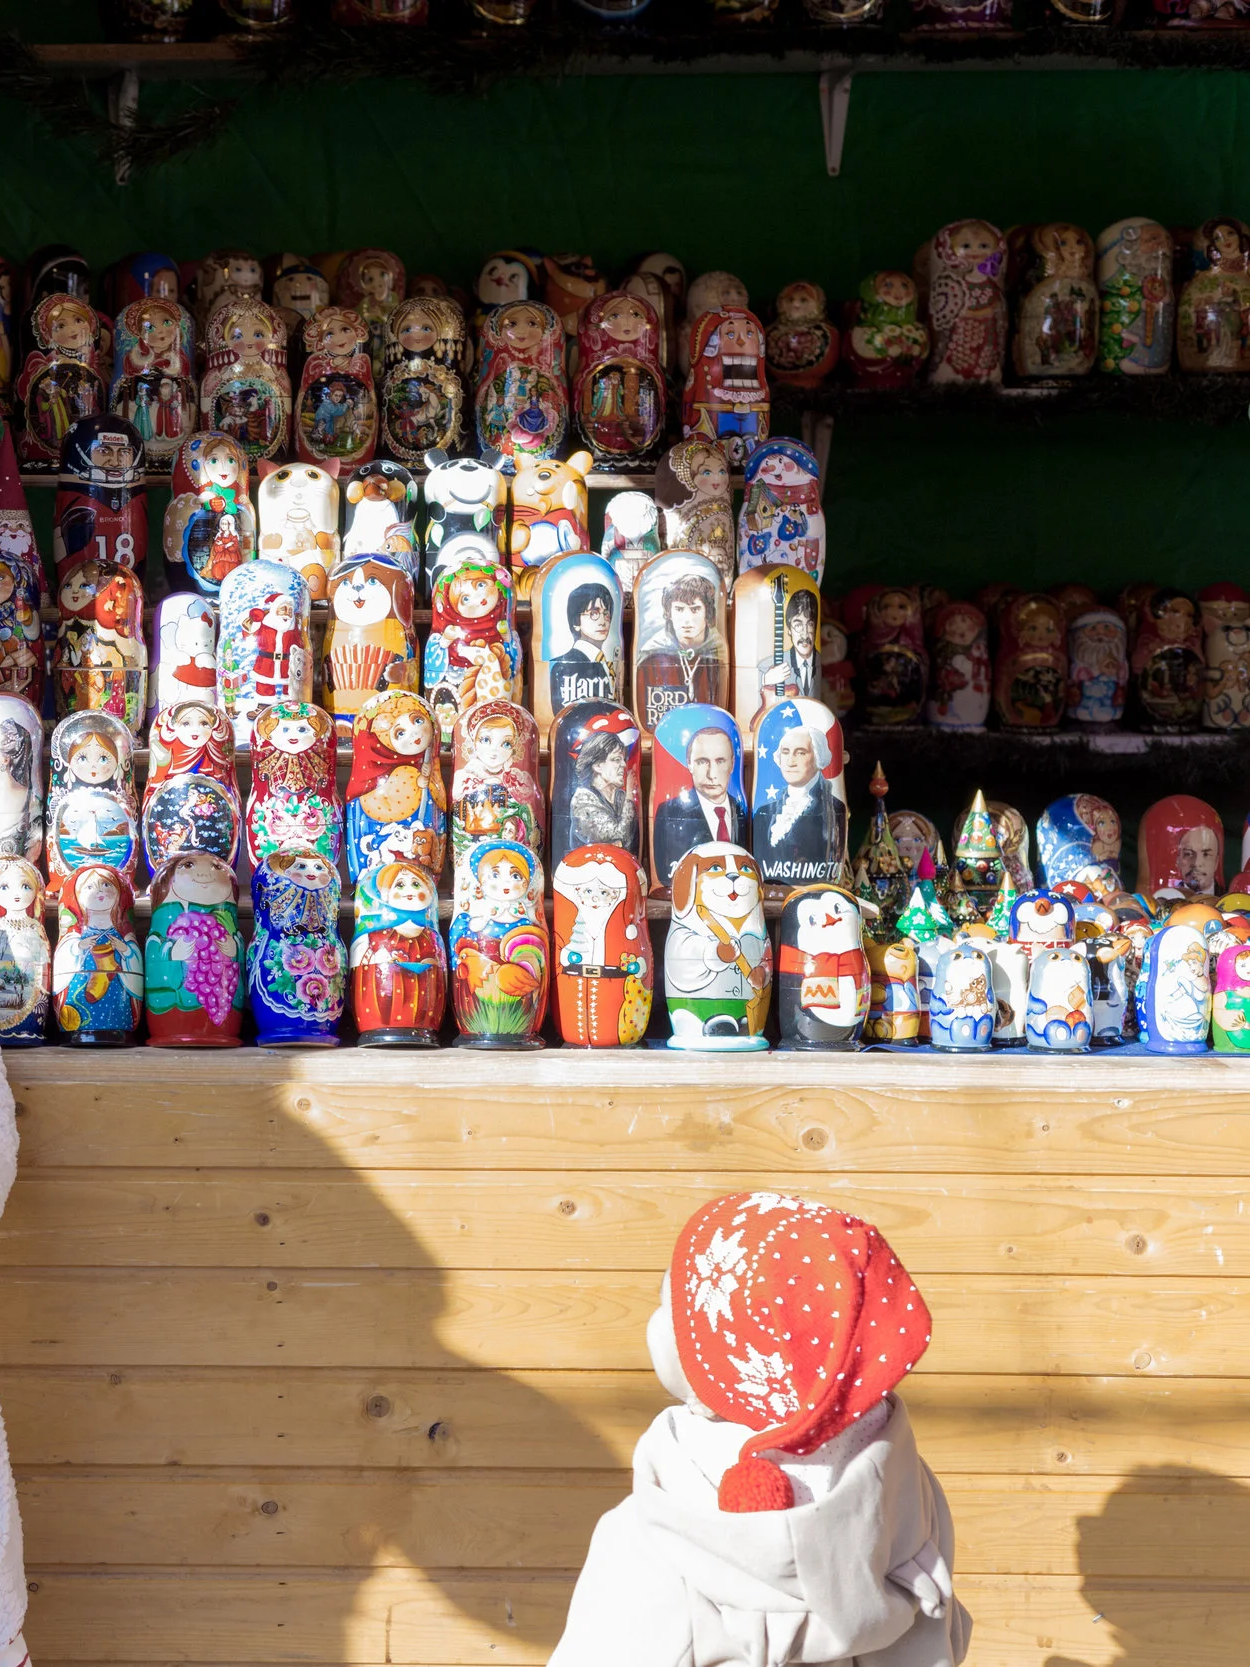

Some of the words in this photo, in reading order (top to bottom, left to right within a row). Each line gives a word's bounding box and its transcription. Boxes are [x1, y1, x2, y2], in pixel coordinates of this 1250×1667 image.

[95, 533, 135, 570] 18
[646, 686, 688, 708] LORD
[1209, 920, 1217, 930] A
